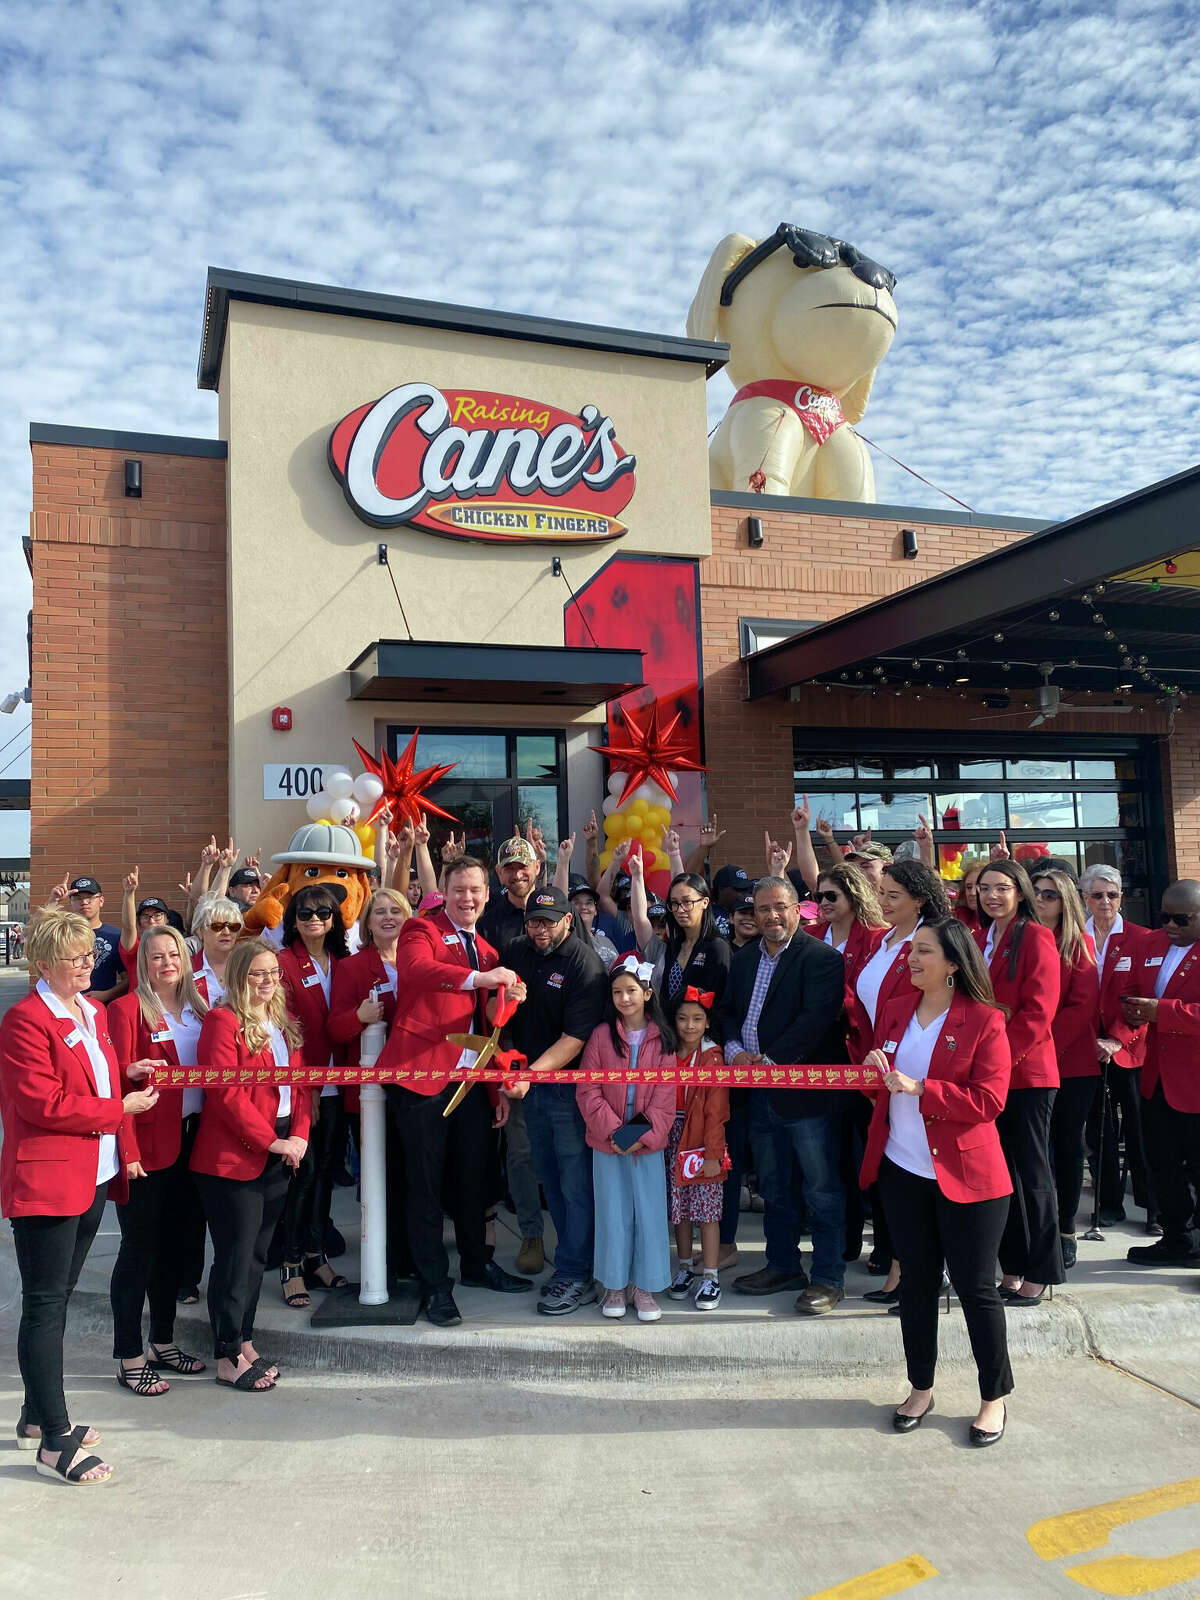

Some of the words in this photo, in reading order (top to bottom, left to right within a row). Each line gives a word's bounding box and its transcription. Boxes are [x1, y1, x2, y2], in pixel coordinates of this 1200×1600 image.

[453, 397, 550, 431] Raising
[347, 382, 636, 518] Cane's
[451, 506, 529, 529] CHICKEN
[535, 512, 609, 534] FINGERS
[278, 767, 324, 796] 400
